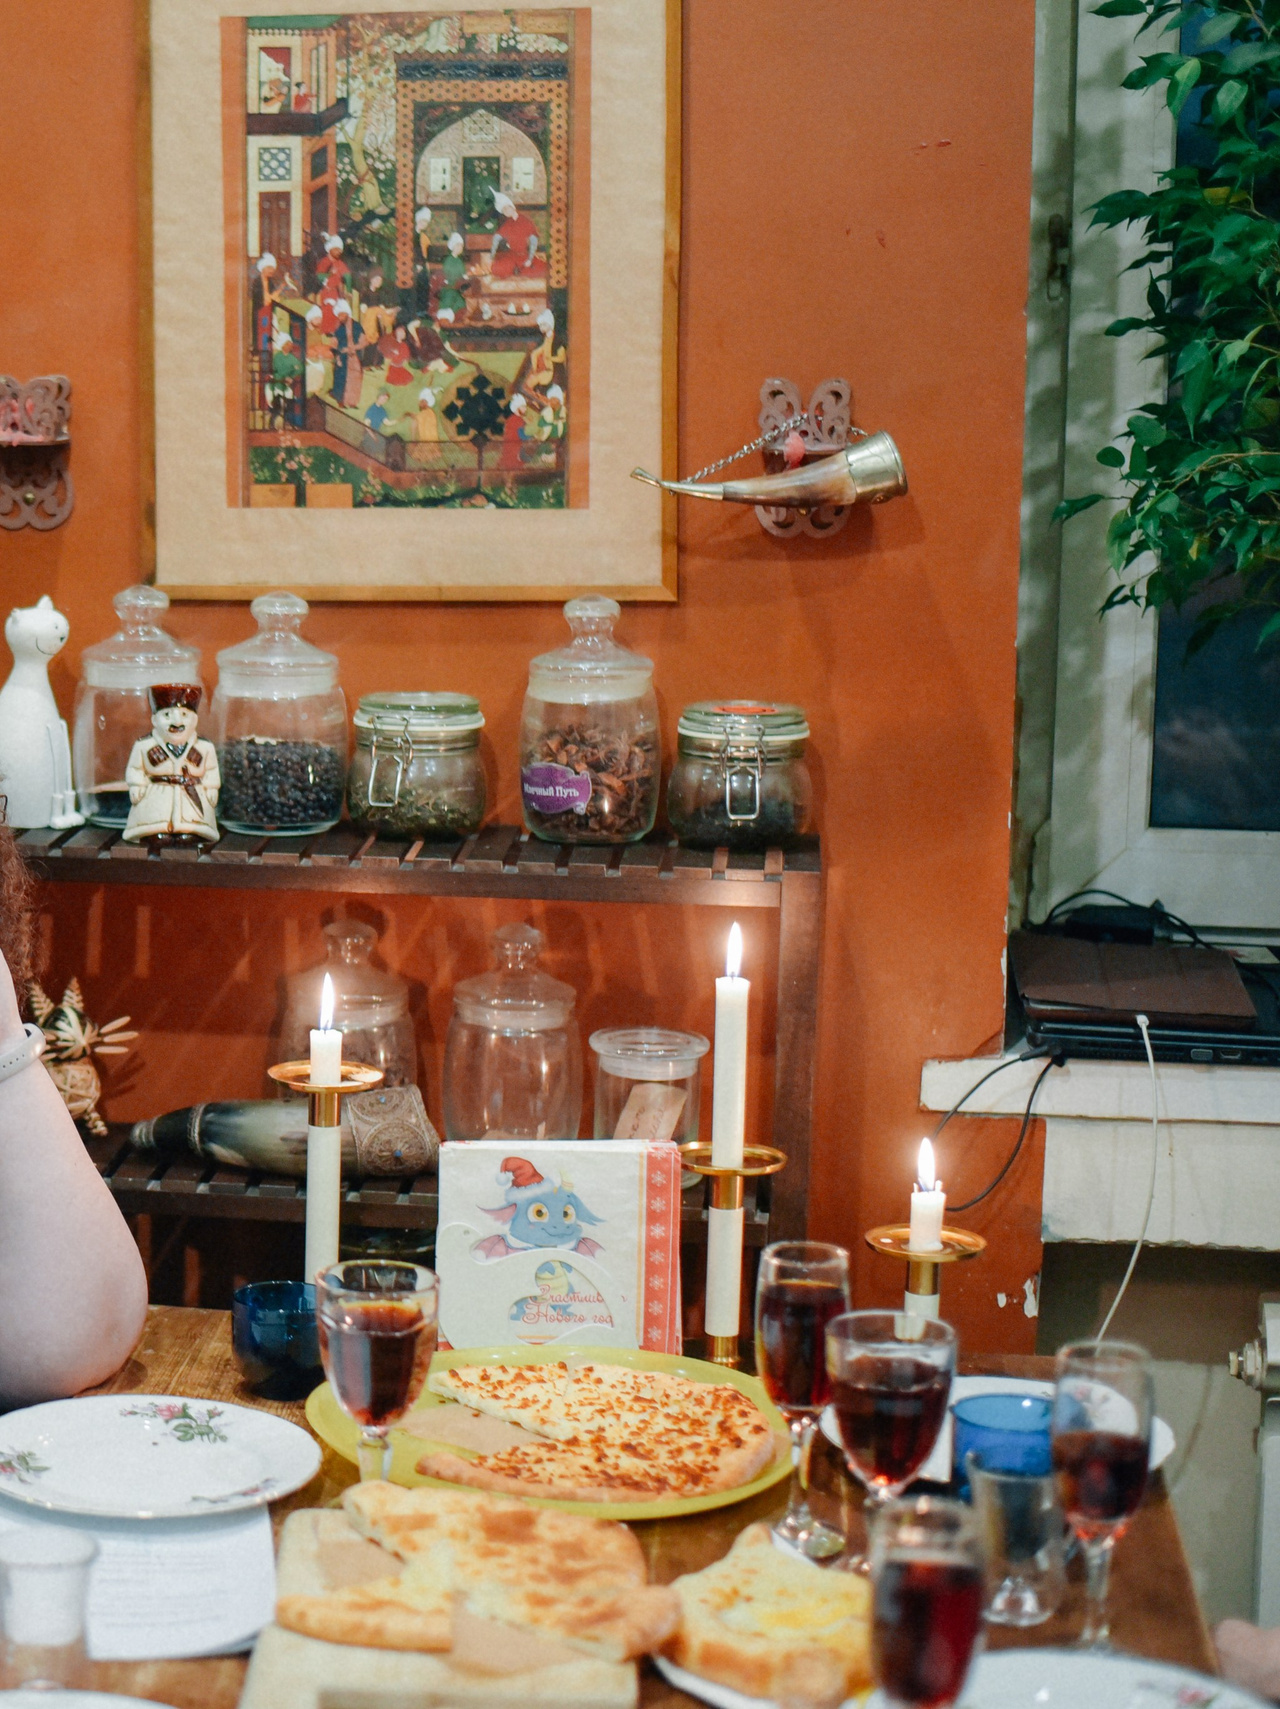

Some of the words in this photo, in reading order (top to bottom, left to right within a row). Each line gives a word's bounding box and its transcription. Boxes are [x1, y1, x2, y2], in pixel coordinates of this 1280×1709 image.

[556, 786, 580, 799] Путь
[529, 1284, 627, 1304] Счастлив
[522, 1303, 586, 1324] Нового
[592, 1314, 614, 1328] год
